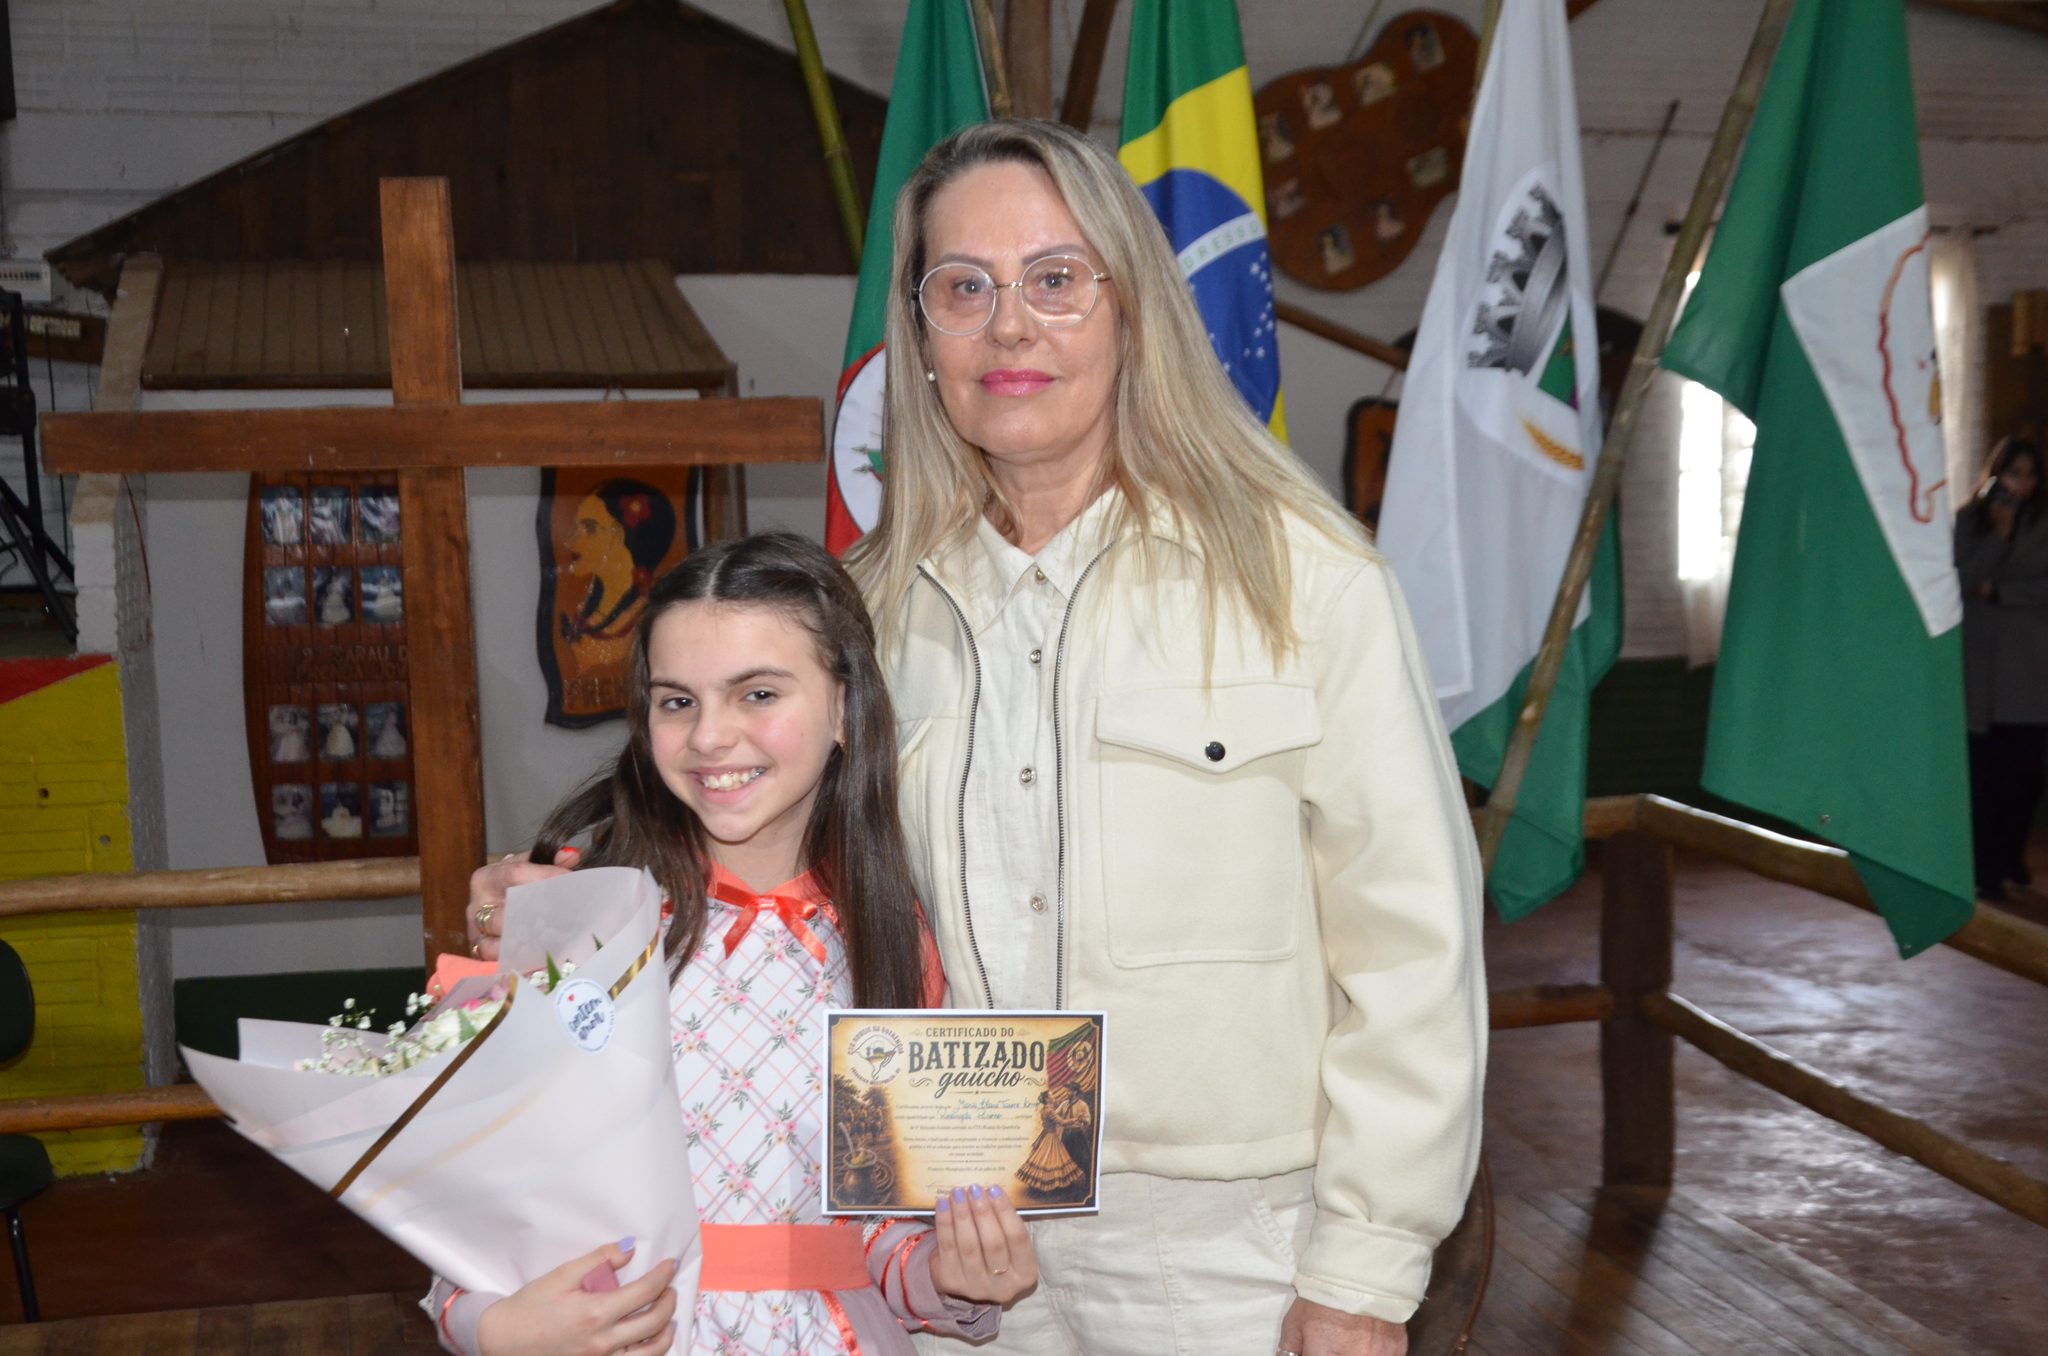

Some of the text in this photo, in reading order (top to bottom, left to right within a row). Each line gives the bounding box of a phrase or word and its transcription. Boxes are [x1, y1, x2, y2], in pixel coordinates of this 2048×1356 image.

[1184, 220, 1258, 269] GRESSO
[926, 1027, 1014, 1038] CERTIFICADO DO
[908, 1041, 1045, 1073] BATIZADO
[934, 1058, 1025, 1099] gaúcho
